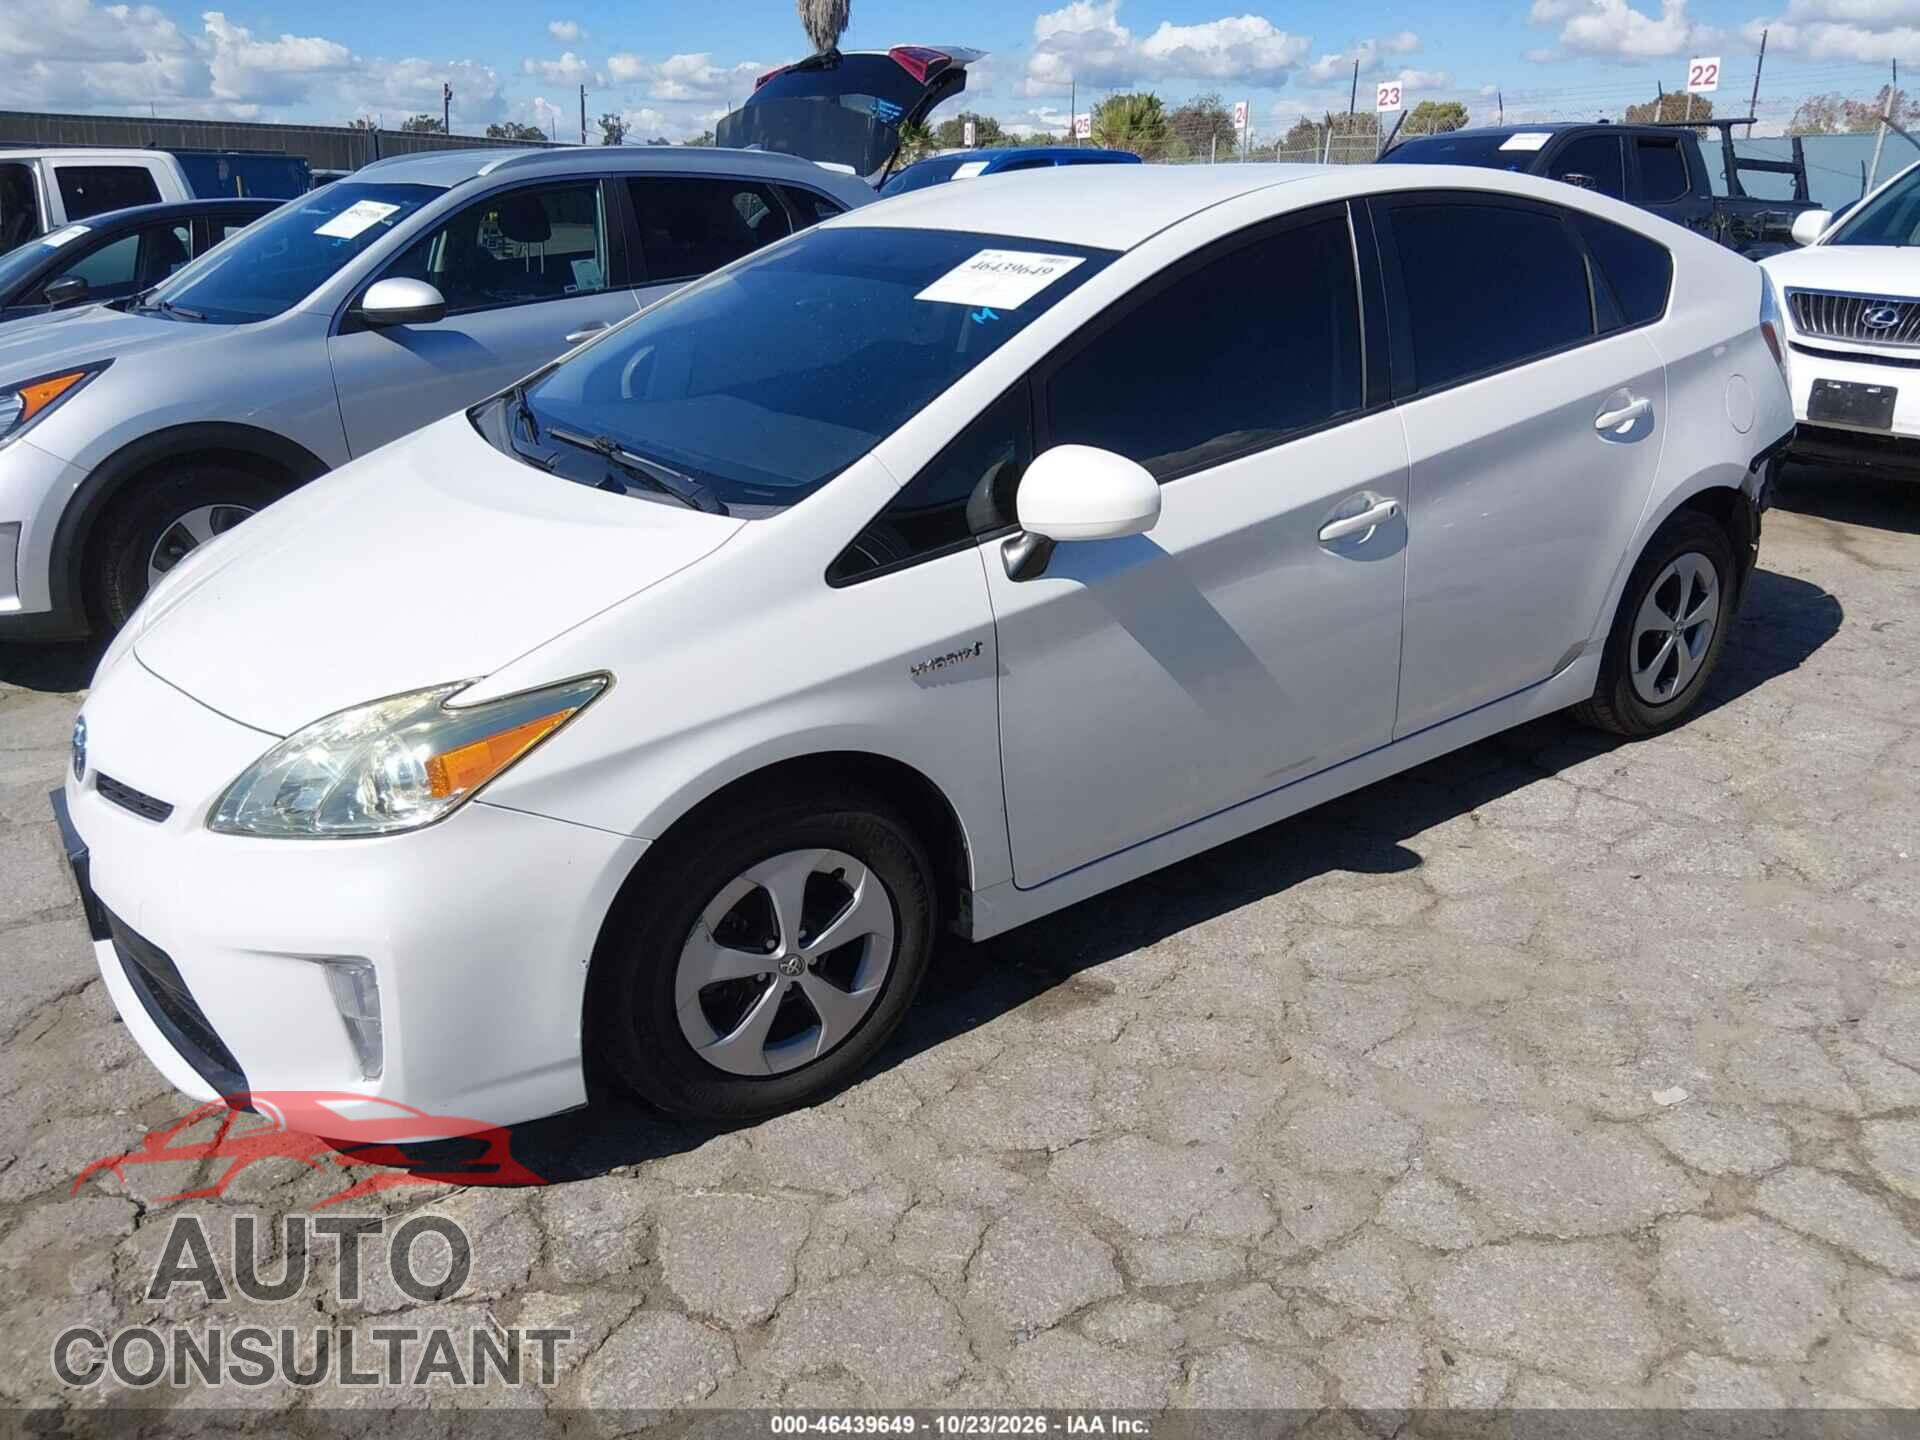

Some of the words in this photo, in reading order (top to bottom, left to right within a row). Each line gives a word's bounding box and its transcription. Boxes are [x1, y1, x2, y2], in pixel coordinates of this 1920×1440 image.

[1689, 64, 1718, 86] 22
[1378, 87, 1400, 106] 23
[1077, 118, 1090, 134] 25
